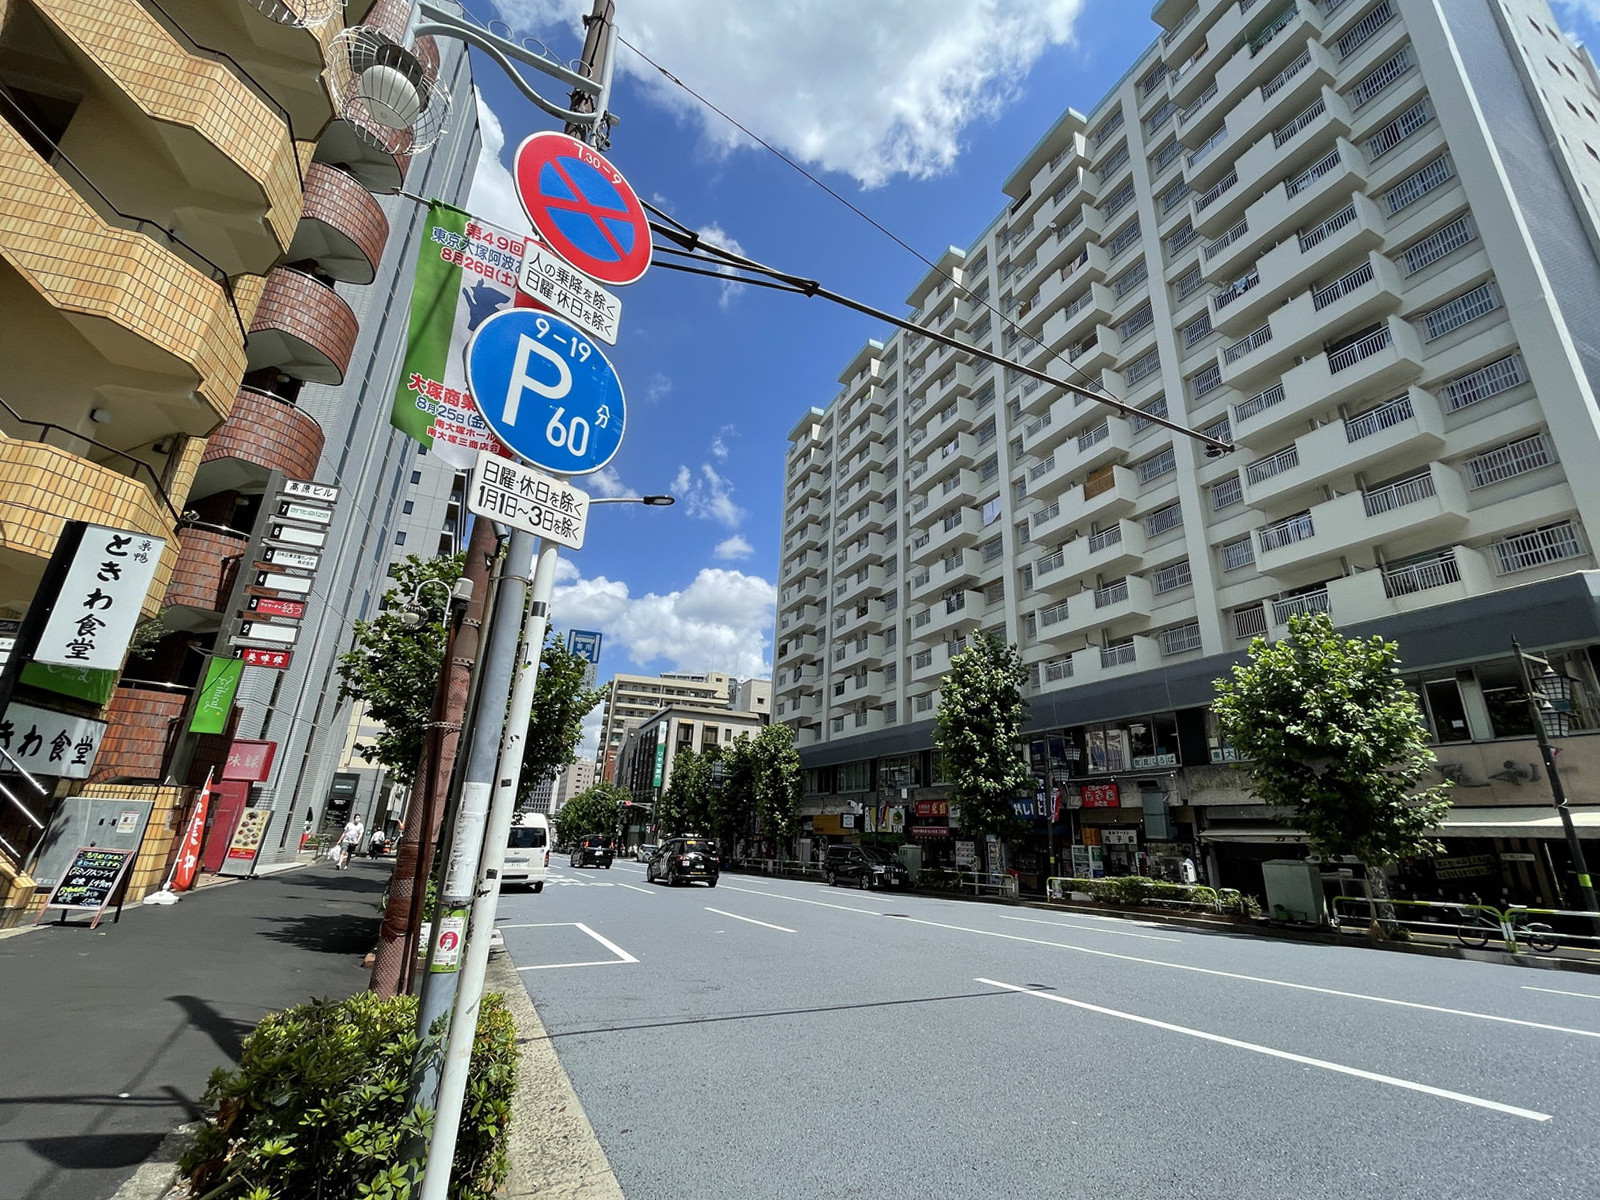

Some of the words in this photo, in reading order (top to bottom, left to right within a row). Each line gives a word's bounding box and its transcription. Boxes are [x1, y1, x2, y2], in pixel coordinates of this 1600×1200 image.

[465, 221, 525, 257] 第49回
[441, 247, 518, 288] 8月26日(土)
[529, 252, 615, 318] 人の乗降を除く
[535, 318, 592, 362] 9-19
[502, 333, 573, 427] P
[427, 427, 500, 452] 南大塚三商店会
[545, 407, 590, 457] 60
[594, 404, 611, 429] 分
[281, 504, 288, 513] 7
[273, 527, 280, 536] 6
[265, 550, 273, 559] 5
[258, 574, 265, 583] 4
[64, 534, 133, 661] ときわ食堂
[250, 598, 258, 608] 3
[242, 624, 249, 633] 2
[235, 649, 242, 659] 1
